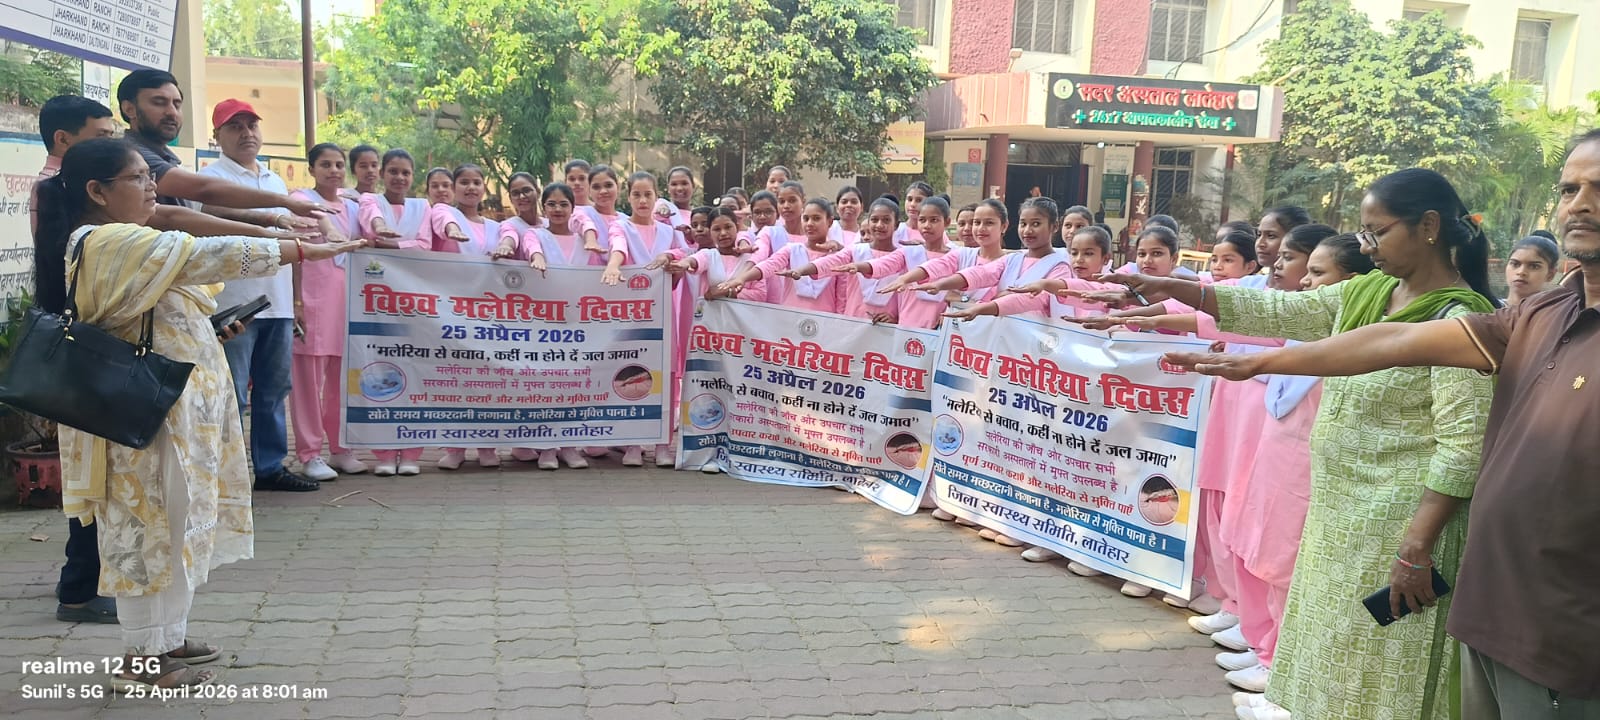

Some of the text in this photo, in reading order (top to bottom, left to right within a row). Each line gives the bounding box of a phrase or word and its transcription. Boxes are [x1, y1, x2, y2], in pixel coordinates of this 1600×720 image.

[55, 8, 88, 26] JHARKHAND
[91, 19, 110, 33] RANCHI
[94, 3, 112, 16] RANCHI
[52, 26, 86, 43] JHARKHAND
[1076, 83, 1237, 110] सदर अस्पताल लातेहार
[1123, 110, 1195, 127] आपातकालीन
[1195, 111, 1220, 129] सेवा
[361, 284, 655, 321] विश्व मलेरिया दिवस
[442, 324, 585, 343] 25 अप्रैल 2026
[435, 346, 446, 358] से
[451, 350, 490, 361] बचाव,
[494, 348, 520, 361] कहीं
[524, 352, 538, 361] ना
[543, 350, 565, 361] होने
[570, 349, 580, 362] दें
[583, 352, 604, 361] जल
[690, 325, 928, 392] विश्व मलेरिया दिवस
[436, 364, 591, 377] मलेरिया और उपचार सभी
[743, 365, 866, 399] 25 अप्रैल 2026
[423, 377, 457, 388] सरकारी
[463, 378, 506, 388] अस्पतालों
[524, 382, 544, 391] मुफ्त
[549, 381, 581, 389] उपलब्ध
[585, 378, 592, 388] है
[997, 354, 1091, 405] मलेरिया
[1099, 373, 1194, 419] दिवस
[410, 392, 427, 403] पूर्ण
[495, 394, 512, 403] और
[516, 393, 552, 403] मलेरिया
[556, 393, 563, 402] से
[567, 393, 590, 404] मुक्ति
[737, 384, 746, 395] से
[750, 387, 778, 404] बचाव,
[782, 395, 804, 407] कहीं
[807, 400, 819, 410] ना
[823, 401, 844, 415] होने
[848, 405, 858, 417] दें
[859, 409, 877, 422] जल
[988, 387, 1109, 432] 25 अप्रैल 2026
[368, 407, 636, 420] सोते समय मच्छरदानी लगाना मलेरिया से मुक्ति पाना है
[736, 400, 766, 413] मलेरिया
[801, 414, 816, 424] और
[820, 419, 846, 432] उपचार
[850, 424, 864, 435] सभी
[397, 426, 436, 439] जिला
[442, 429, 499, 439] स्वास्थ्य
[561, 424, 614, 437] लातेहार
[983, 410, 993, 423] से
[996, 415, 1024, 435] बचाव,
[1028, 423, 1049, 440] कहीं
[1052, 430, 1063, 445] ना
[1066, 434, 1086, 452] होने
[1091, 439, 1101, 456] दें
[1106, 444, 1131, 459] जल
[768, 447, 796, 460] लगाना
[799, 441, 829, 456] मलेरिया
[831, 447, 839, 457] से
[986, 431, 1116, 476] मलेरिया की और उपचार सभी
[735, 460, 785, 476] स्वास्थ्य
[977, 441, 1000, 457] सरकारी
[1003, 452, 1036, 470] अस्पतालों
[1050, 465, 1069, 479] मुफ्त
[1072, 471, 1106, 489] उपलब्ध
[1110, 478, 1118, 491] है
[962, 454, 1115, 511] पूर्ण उपचार और मलेरिया से मुक्ति
[948, 468, 969, 483] समय
[970, 474, 1013, 498] मच्छरदानी
[1015, 490, 1041, 508] लगाना
[1056, 501, 1090, 525] मलेरिया
[1093, 511, 1101, 525] से
[1102, 516, 1124, 536] मुक्ति
[1126, 527, 1145, 544] पाना
[1149, 532, 1158, 547] है
[948, 484, 1130, 564] जिला स्वास्थ्य समिति, लातेहार
